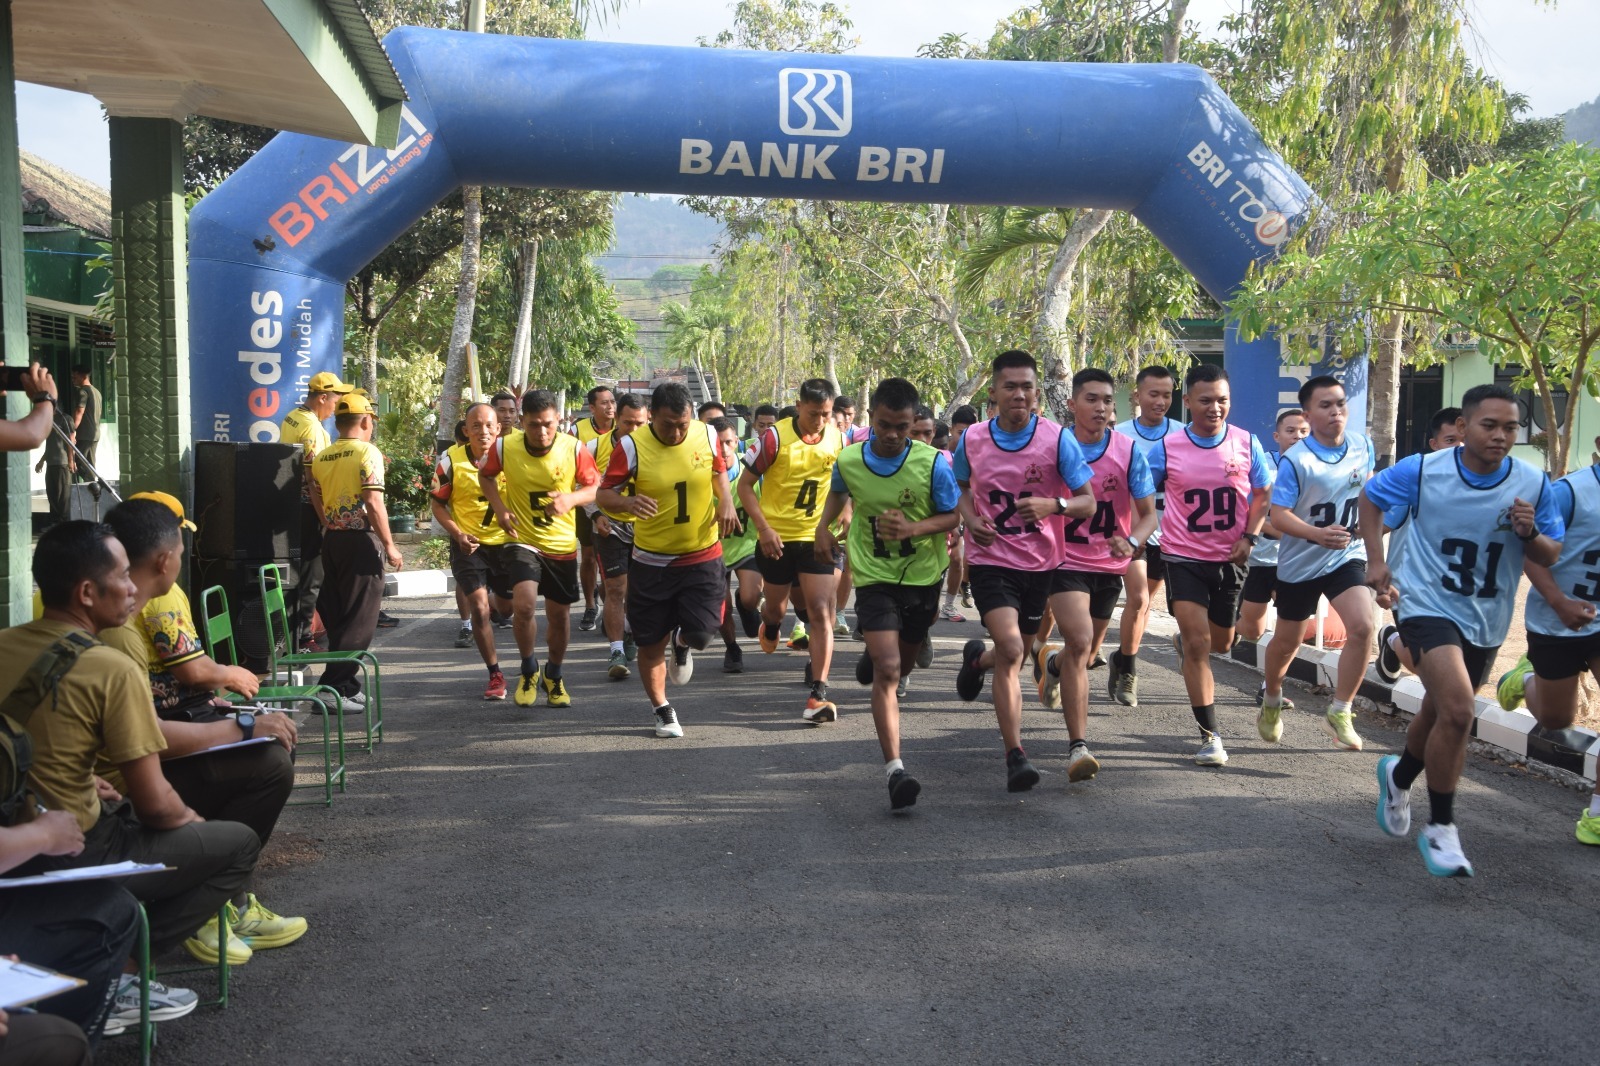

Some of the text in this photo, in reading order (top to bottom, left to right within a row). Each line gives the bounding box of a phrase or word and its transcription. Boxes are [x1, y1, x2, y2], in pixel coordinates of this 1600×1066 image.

[367, 132, 434, 195] uang isi ulang BRI
[679, 138, 946, 184] BANK BRI
[1186, 140, 1233, 189] BRI
[1219, 210, 1261, 256] PERSONAL
[296, 298, 312, 368] Mudah
[214, 413, 230, 443] BRI
[529, 490, 554, 528] 5
[674, 481, 690, 525] 1
[794, 479, 819, 517] 4
[1184, 486, 1238, 533] 29
[1064, 500, 1118, 545] 24
[1441, 537, 1505, 599] 31
